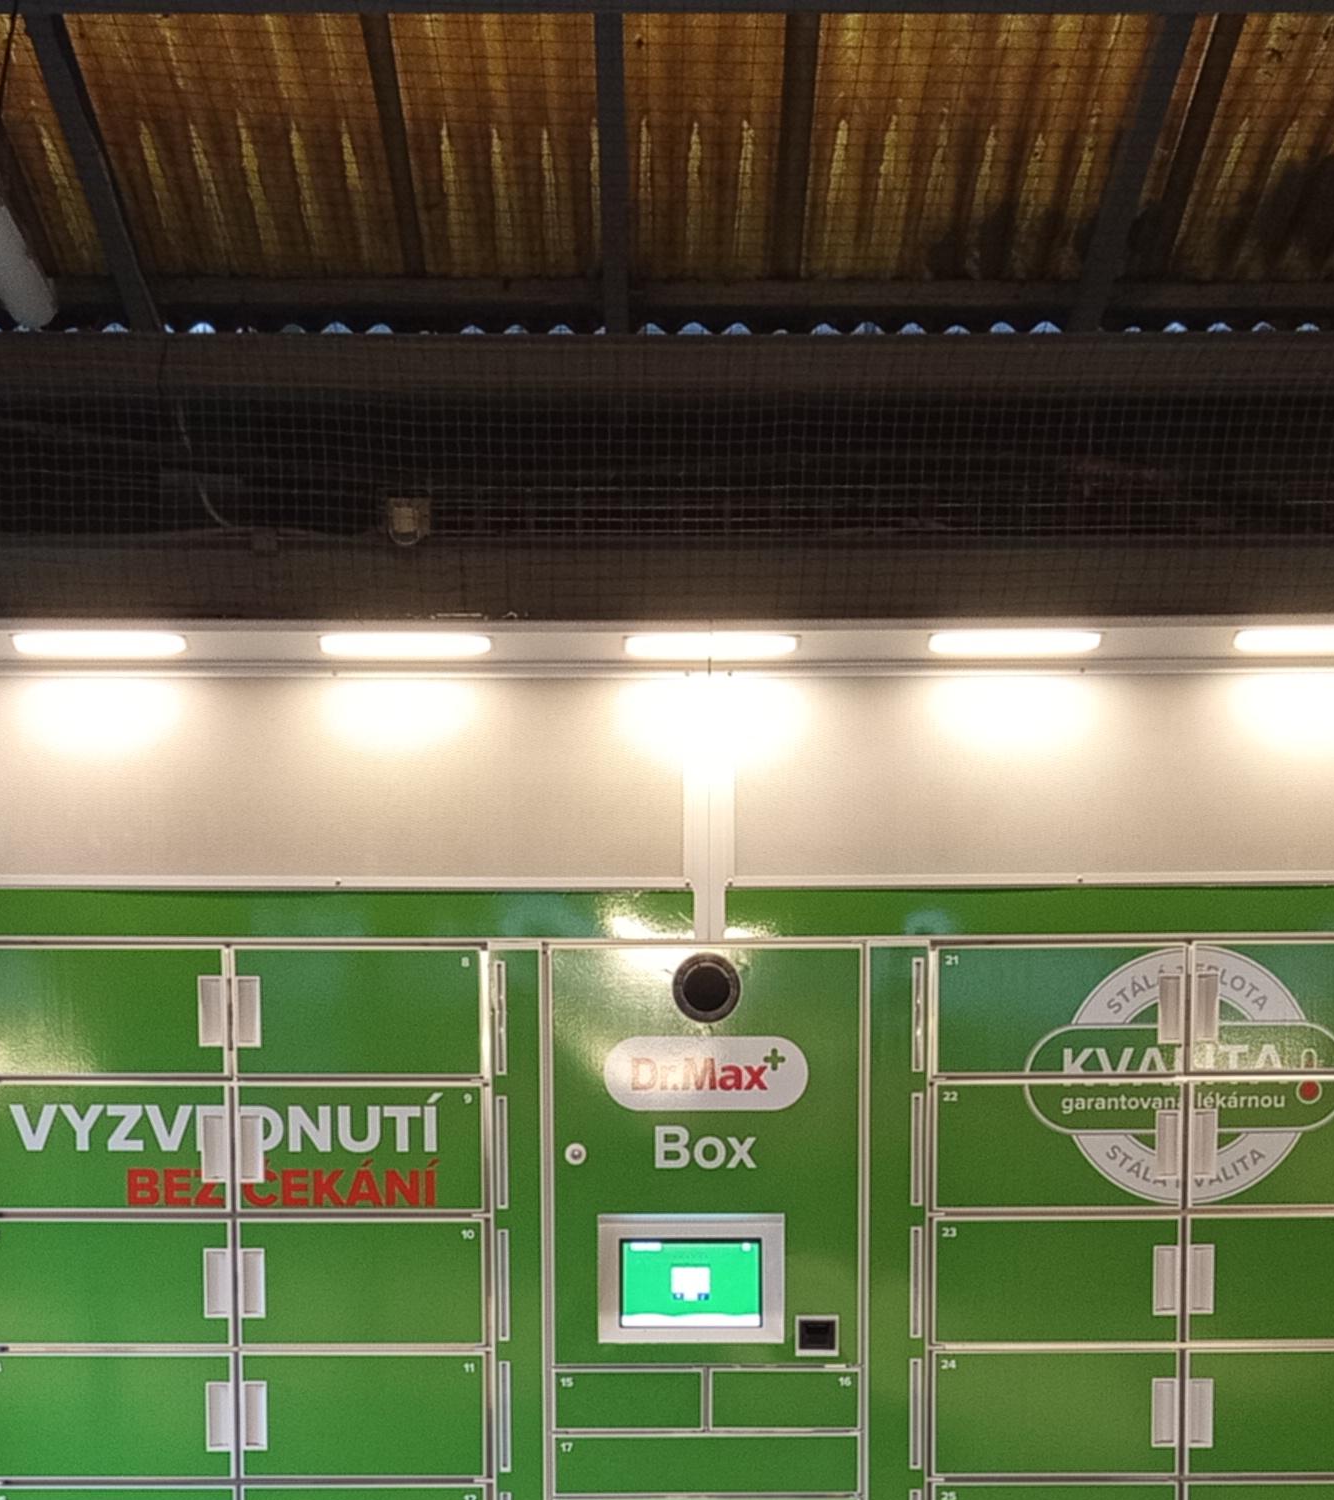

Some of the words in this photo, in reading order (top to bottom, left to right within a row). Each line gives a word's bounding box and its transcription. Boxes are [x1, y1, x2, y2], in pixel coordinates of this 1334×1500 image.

[945, 955, 959, 966] 21
[1107, 964, 1167, 1015] STÁL
[942, 1090, 958, 1102] 22
[1061, 1095, 1184, 1115] garantovan
[1197, 1090, 1286, 1109] lékárnou
[653, 1125, 758, 1169] Box
[461, 1228, 476, 1240] 10
[942, 1227, 957, 1238] 23
[463, 1362, 475, 1373] 11
[941, 1359, 957, 1370] 24
[560, 1377, 574, 1388] 15
[838, 1376, 852, 1387] 16
[560, 1441, 574, 1452] 17
